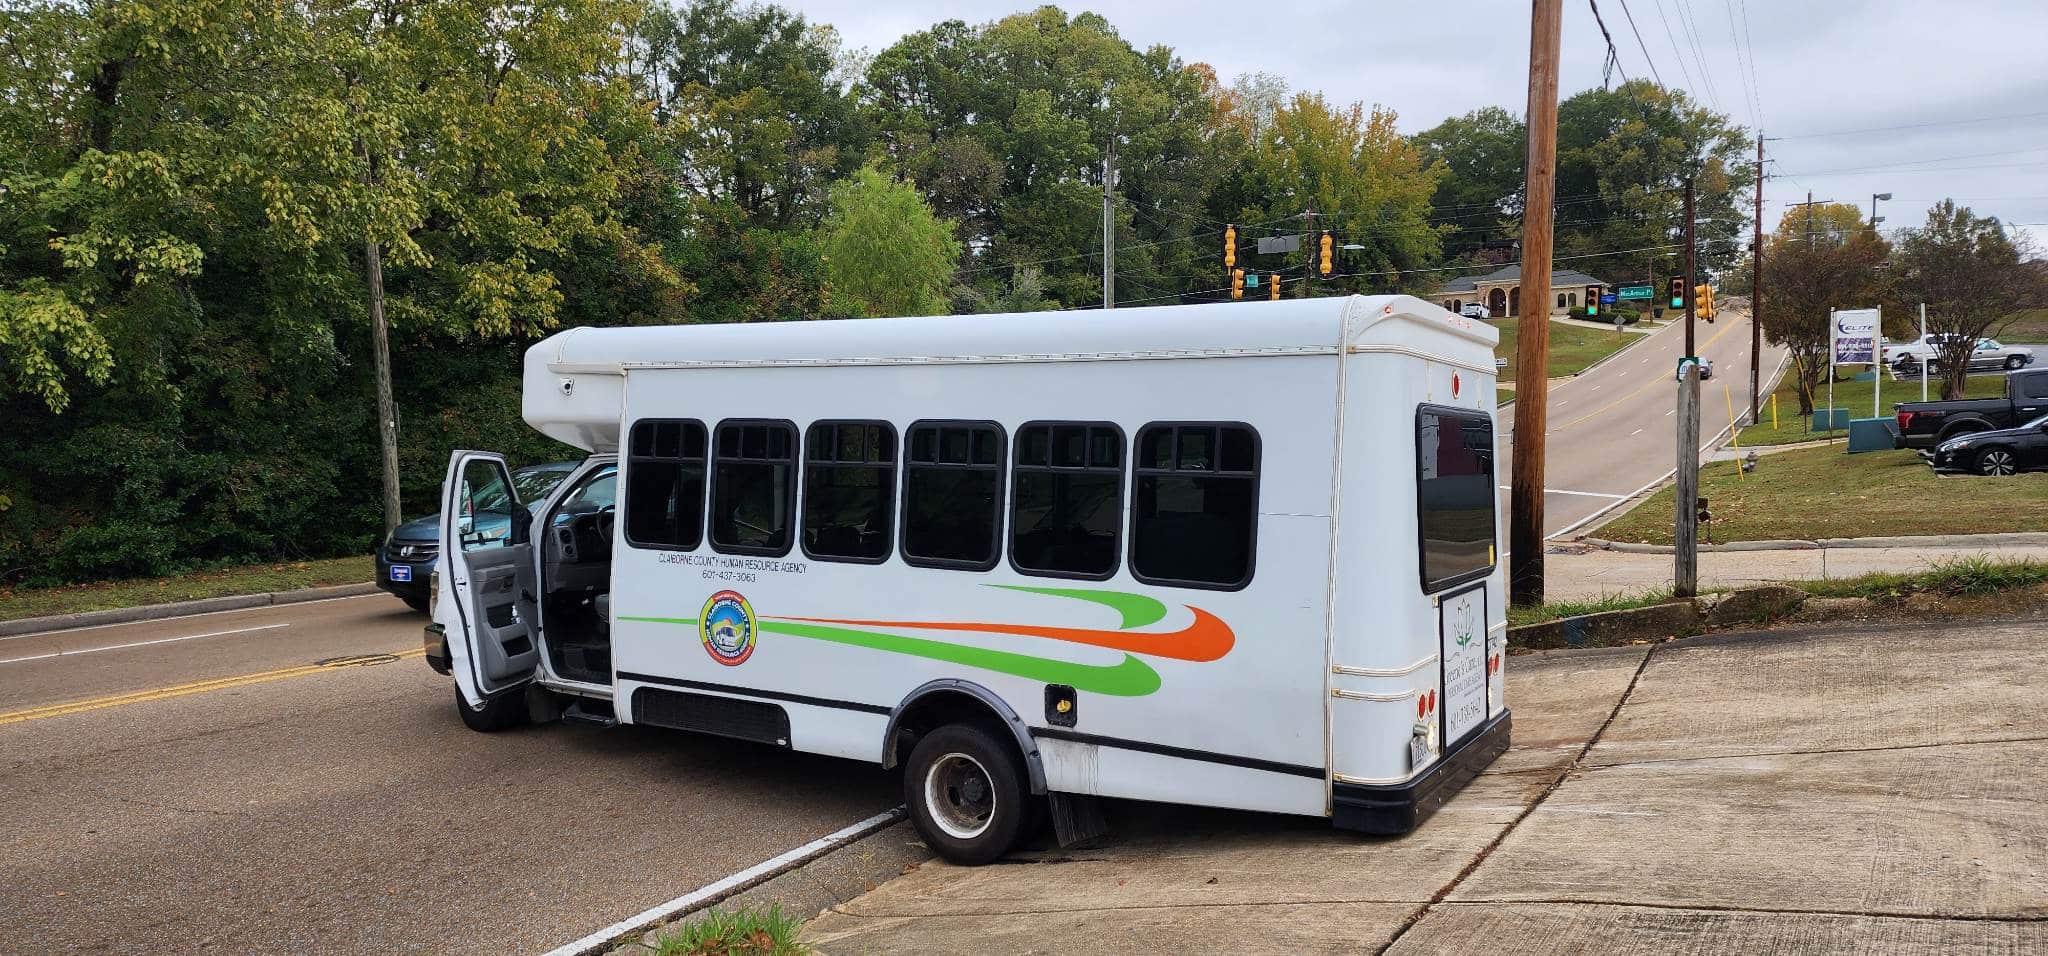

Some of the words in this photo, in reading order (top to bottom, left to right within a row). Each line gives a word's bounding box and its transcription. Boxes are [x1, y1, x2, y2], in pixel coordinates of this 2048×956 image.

[658, 553, 693, 566] CLAIBORNE
[693, 555, 719, 567] COUNTY
[720, 557, 744, 569] HUMAN
[744, 559, 779, 572] RESOURCE
[780, 562, 808, 574] AGENCY
